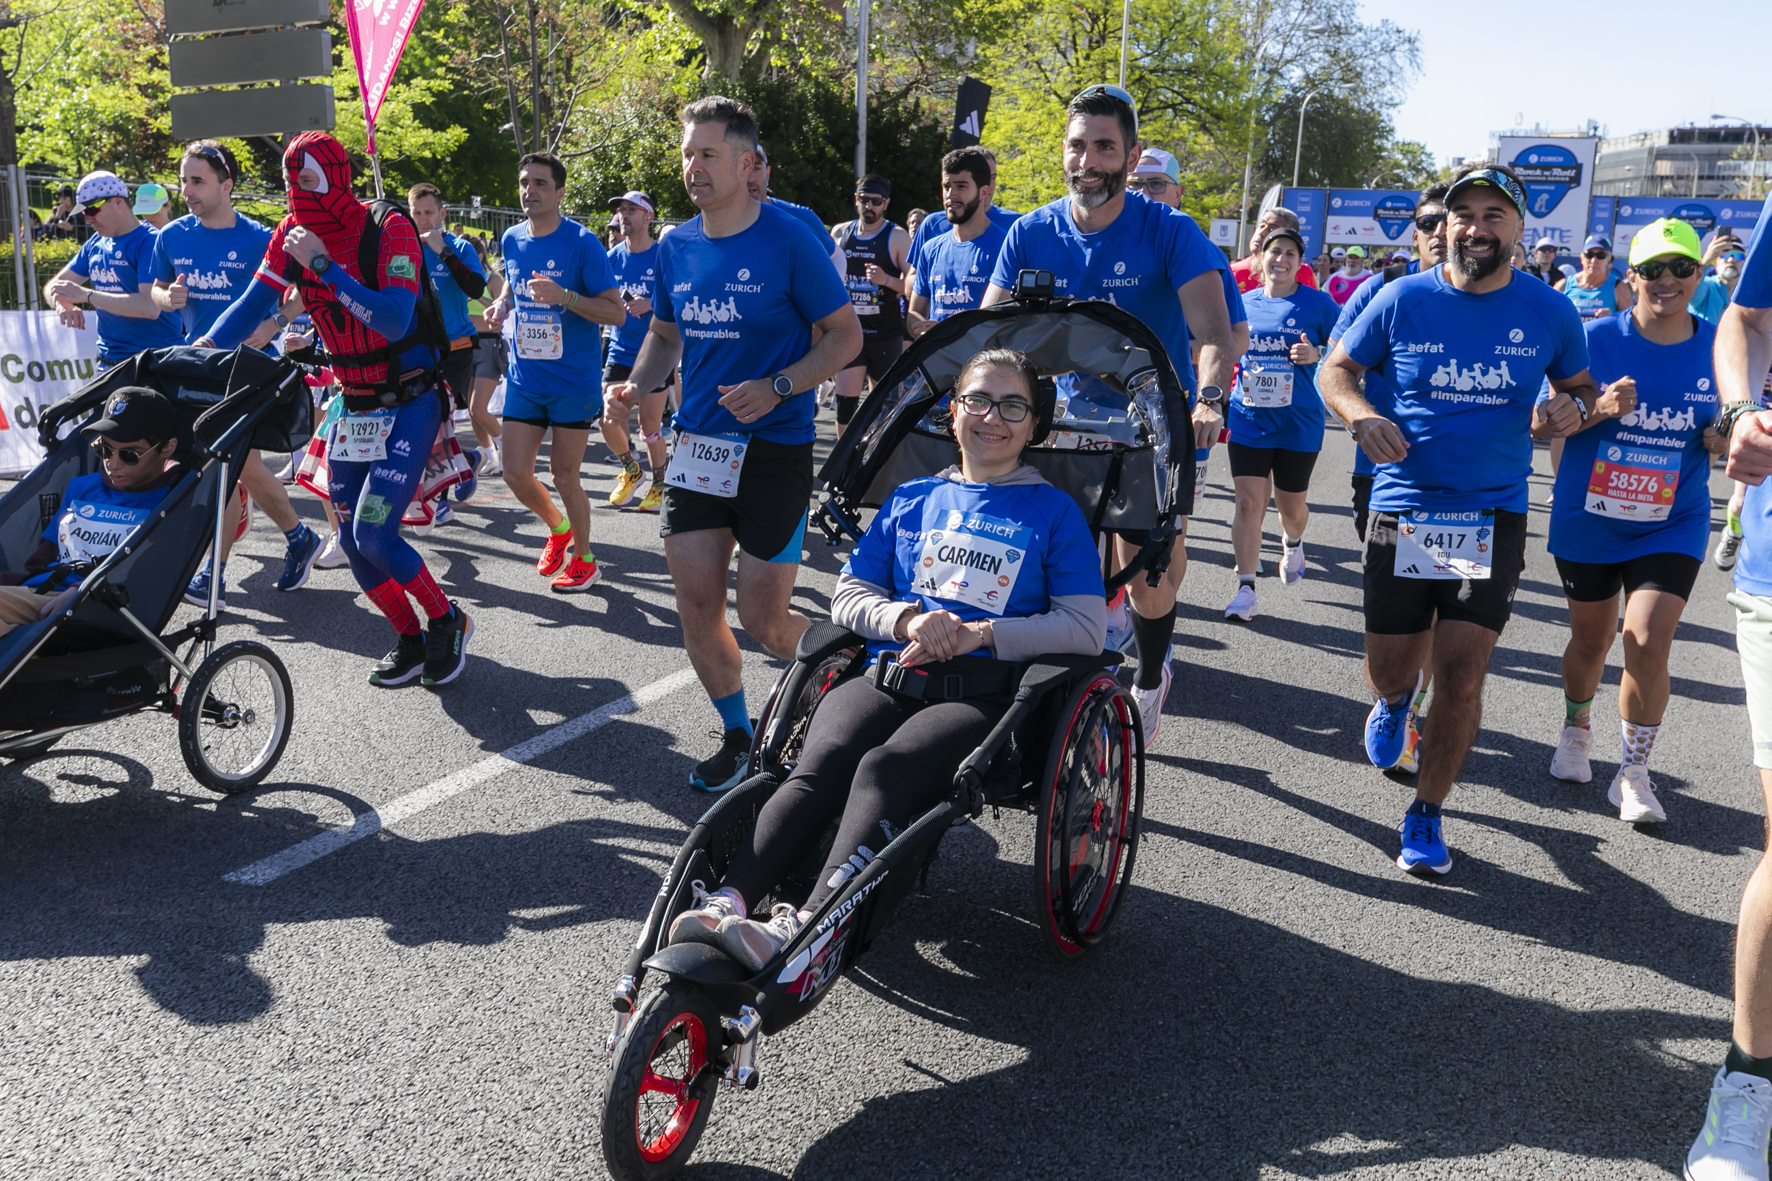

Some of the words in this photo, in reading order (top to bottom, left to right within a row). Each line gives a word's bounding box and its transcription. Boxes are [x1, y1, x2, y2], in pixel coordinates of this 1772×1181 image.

[1521, 226, 1572, 244] ENTE
[109, 258, 129, 266] ZURICH
[218, 261, 246, 269] ZURICH
[430, 270, 451, 278] ZURICH
[540, 269, 563, 278] ZURICH
[961, 275, 986, 283] ZURICH
[724, 283, 761, 293] ZURICH
[1102, 278, 1139, 287] ZURICH
[851, 292, 872, 301] 27286
[526, 328, 548, 340] 3356
[685, 328, 741, 340] #Imparables
[1277, 326, 1303, 335] ZURICH
[1407, 342, 1444, 353] aefat
[1494, 345, 1537, 357] ZURICH
[1, 354, 95, 384] Comu
[1255, 376, 1278, 387] 7801
[1430, 390, 1509, 405] #Imparables
[1683, 393, 1719, 403] ZURICH
[351, 422, 379, 436] 12921
[1616, 431, 1687, 448] #Imparables
[692, 442, 730, 464] 12639
[1625, 452, 1668, 465] ZURICH
[374, 467, 408, 483] aefat
[1608, 470, 1658, 493] 58576
[1608, 488, 1627, 498] HASTA
[1628, 492, 1636, 500] LA
[1637, 494, 1653, 502] META
[98, 509, 136, 521] ZURICH
[1433, 512, 1479, 521] ZURICH
[967, 519, 1014, 539] ZURICH
[70, 527, 121, 547] ADRIÁN
[1423, 532, 1467, 549] 6417
[938, 545, 1003, 576] CARMEN
